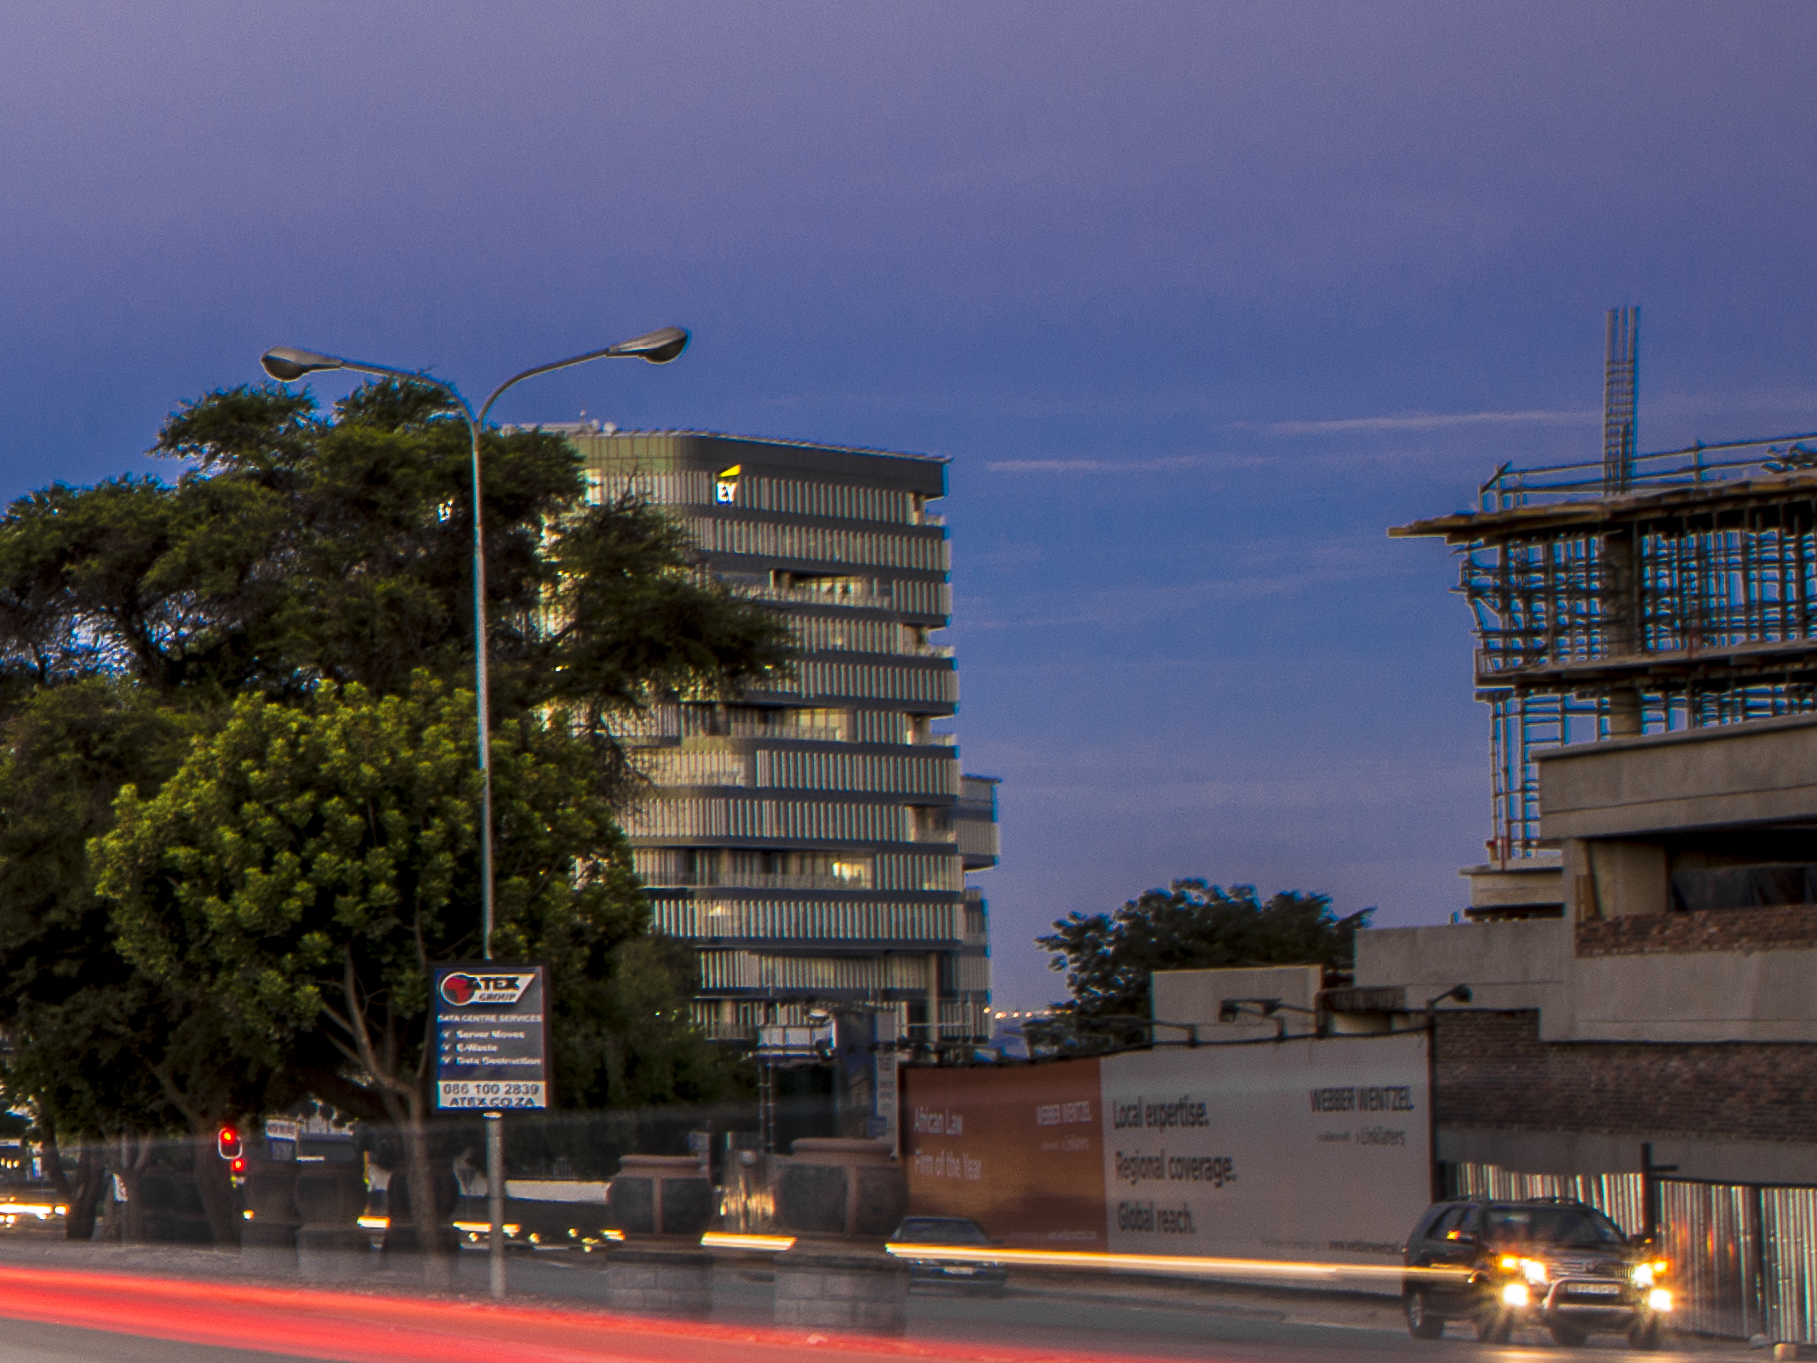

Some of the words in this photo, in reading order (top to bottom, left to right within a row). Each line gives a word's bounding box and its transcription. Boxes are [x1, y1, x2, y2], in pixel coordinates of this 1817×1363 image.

[716, 480, 738, 504] EY
[478, 992, 518, 1002] GROUP
[1113, 1096, 1143, 1130] Local
[1116, 1148, 1165, 1186] Regional
[1168, 1155, 1238, 1188] coverage.
[1118, 1200, 1155, 1232] Global
[1156, 1202, 1197, 1235] reach.
